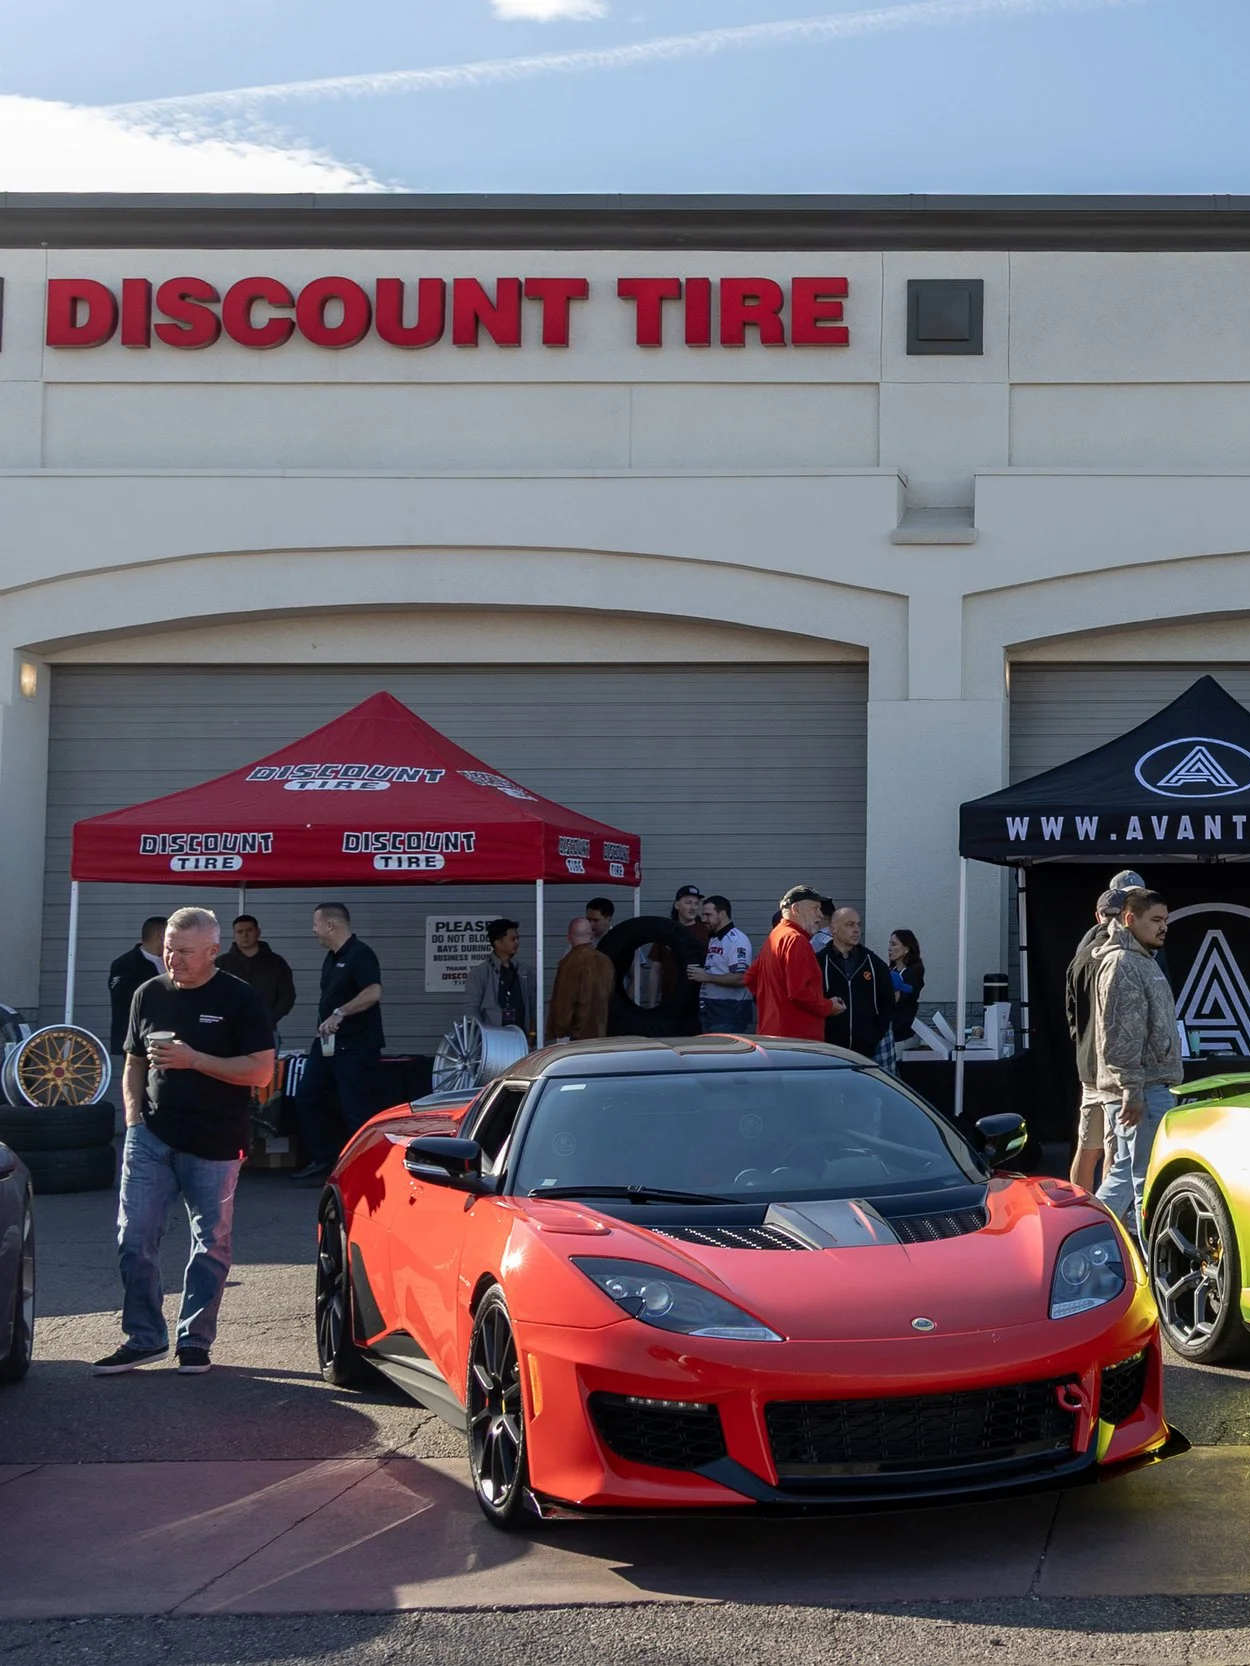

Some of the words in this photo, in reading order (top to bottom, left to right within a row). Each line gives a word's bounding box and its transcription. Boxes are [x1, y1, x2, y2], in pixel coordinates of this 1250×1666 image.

[46, 276, 590, 350] DISCOUNT
[617, 276, 850, 349] TIRE
[245, 763, 446, 784] DISCOUNT
[297, 780, 380, 790] TIRE
[139, 832, 274, 855] DISCOUNT
[342, 831, 476, 854] DISCOUNT
[177, 856, 235, 870] TIRE
[379, 855, 437, 868] TIRE
[432, 934, 444, 943] DO
[447, 934, 465, 943] NOT
[469, 934, 491, 943] BLOC
[437, 945, 458, 953] BAYS
[461, 944, 492, 952] DURING
[433, 954, 468, 962] BUSINESS
